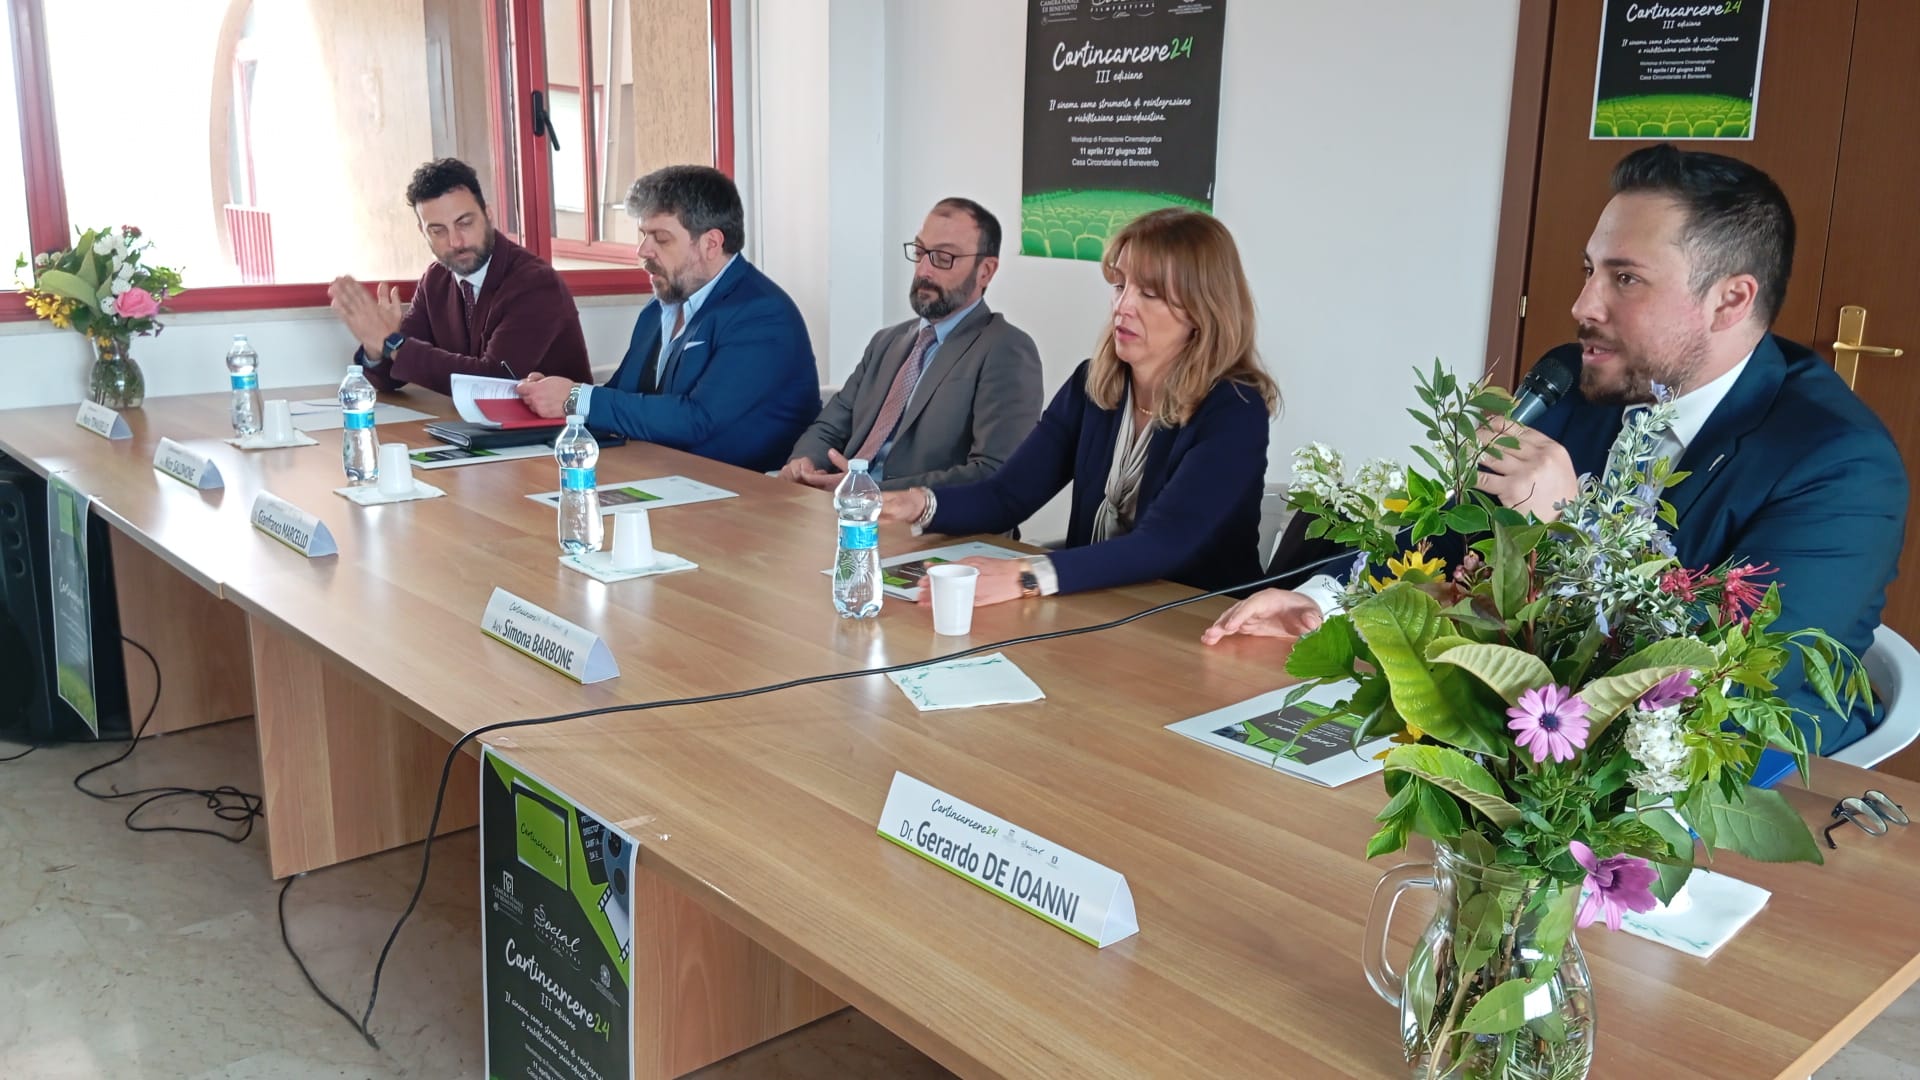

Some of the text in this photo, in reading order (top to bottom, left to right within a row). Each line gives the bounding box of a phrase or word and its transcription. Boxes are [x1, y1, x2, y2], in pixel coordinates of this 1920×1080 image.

[1662, 20, 1675, 30] III
[1096, 70, 1110, 83] III
[1080, 147, 1087, 155] 11
[1087, 147, 1103, 157] aprile
[1107, 147, 1115, 155] 27
[1115, 147, 1137, 157] giugno
[1136, 147, 1152, 155] 2024
[1072, 158, 1086, 166] Casa
[1128, 158, 1160, 167] Benevento
[281, 523, 309, 549] MARCELLO
[502, 619, 533, 649] Simona
[532, 634, 575, 671] BARBONE
[899, 819, 1080, 923] Dr. Gerardo DE IOANNI
[540, 992, 553, 1011] III
